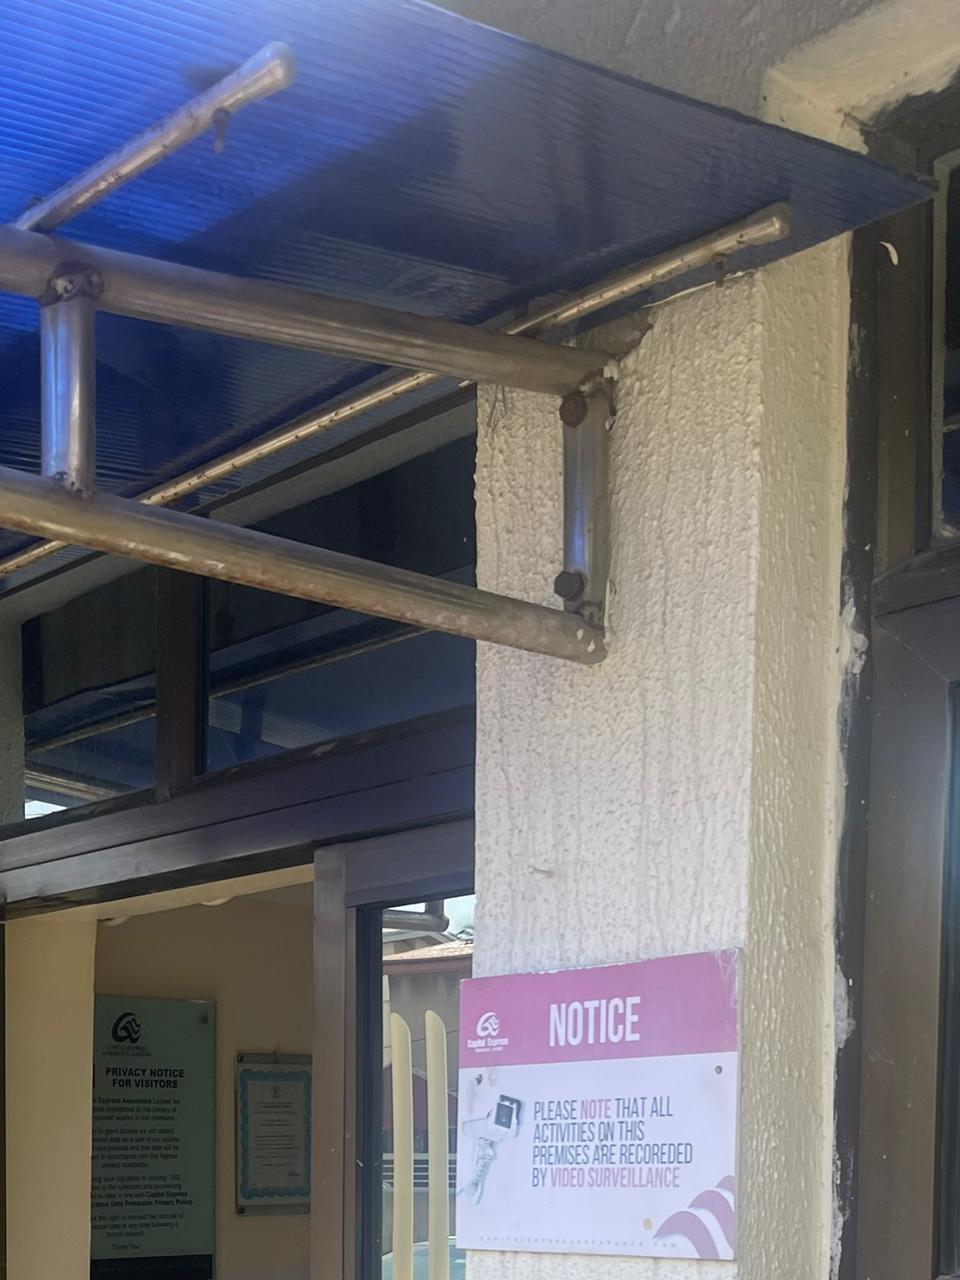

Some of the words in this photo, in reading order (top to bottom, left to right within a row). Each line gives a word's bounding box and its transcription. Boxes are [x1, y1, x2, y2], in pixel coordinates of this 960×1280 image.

[549, 996, 640, 1047] NOTICE
[105, 1067, 147, 1077] PRIVACY
[150, 1068, 185, 1078] NOTICE
[112, 1078, 132, 1088] FOR
[134, 1079, 178, 1088] VISITORS
[533, 1099, 577, 1121] PLEASE
[580, 1098, 612, 1120] NOTE
[614, 1096, 647, 1119] THAT
[650, 1095, 674, 1117] ALL
[533, 1121, 596, 1143] ACTIVITIES
[598, 1121, 615, 1142] ON
[617, 1120, 645, 1141] THIS
[532, 1144, 590, 1165] PREMISES
[592, 1144, 617, 1165] ARE
[619, 1142, 693, 1165] RECOREDED
[532, 1167, 548, 1188] BY
[550, 1167, 585, 1188] VIDEO
[587, 1166, 680, 1188] SURVEILLANCE
